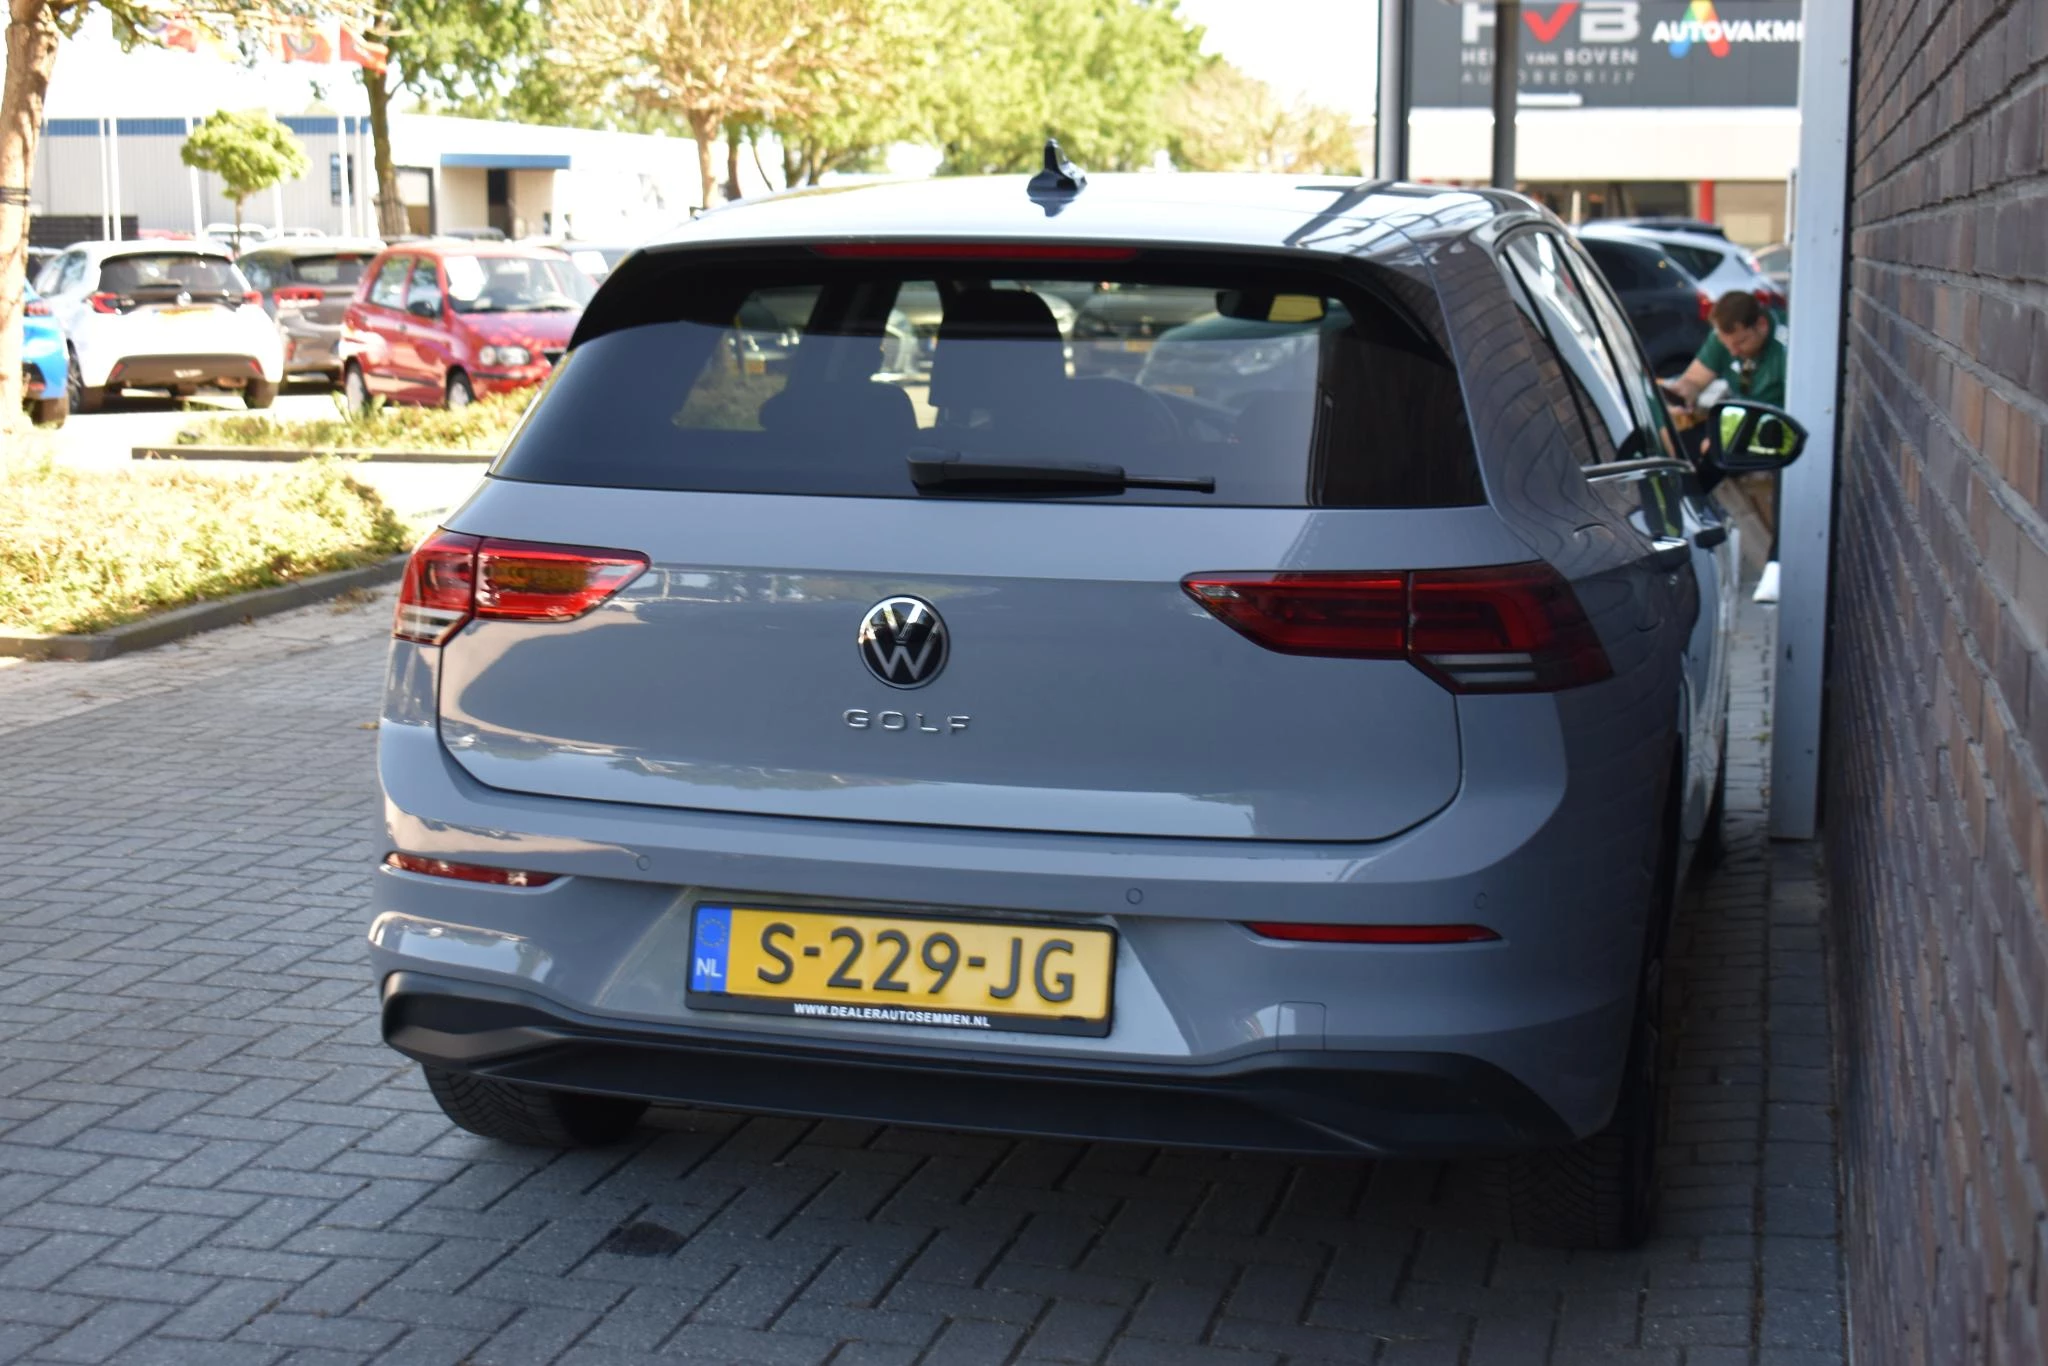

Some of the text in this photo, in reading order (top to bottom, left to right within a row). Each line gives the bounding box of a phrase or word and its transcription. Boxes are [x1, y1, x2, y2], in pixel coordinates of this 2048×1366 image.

[1563, 49, 1639, 66] BOVEN
[1461, 69, 1636, 85] AUOBEDRIJF
[842, 708, 971, 732] GOLF
[695, 957, 723, 978] NL
[757, 921, 1076, 1004] S-229-JG
